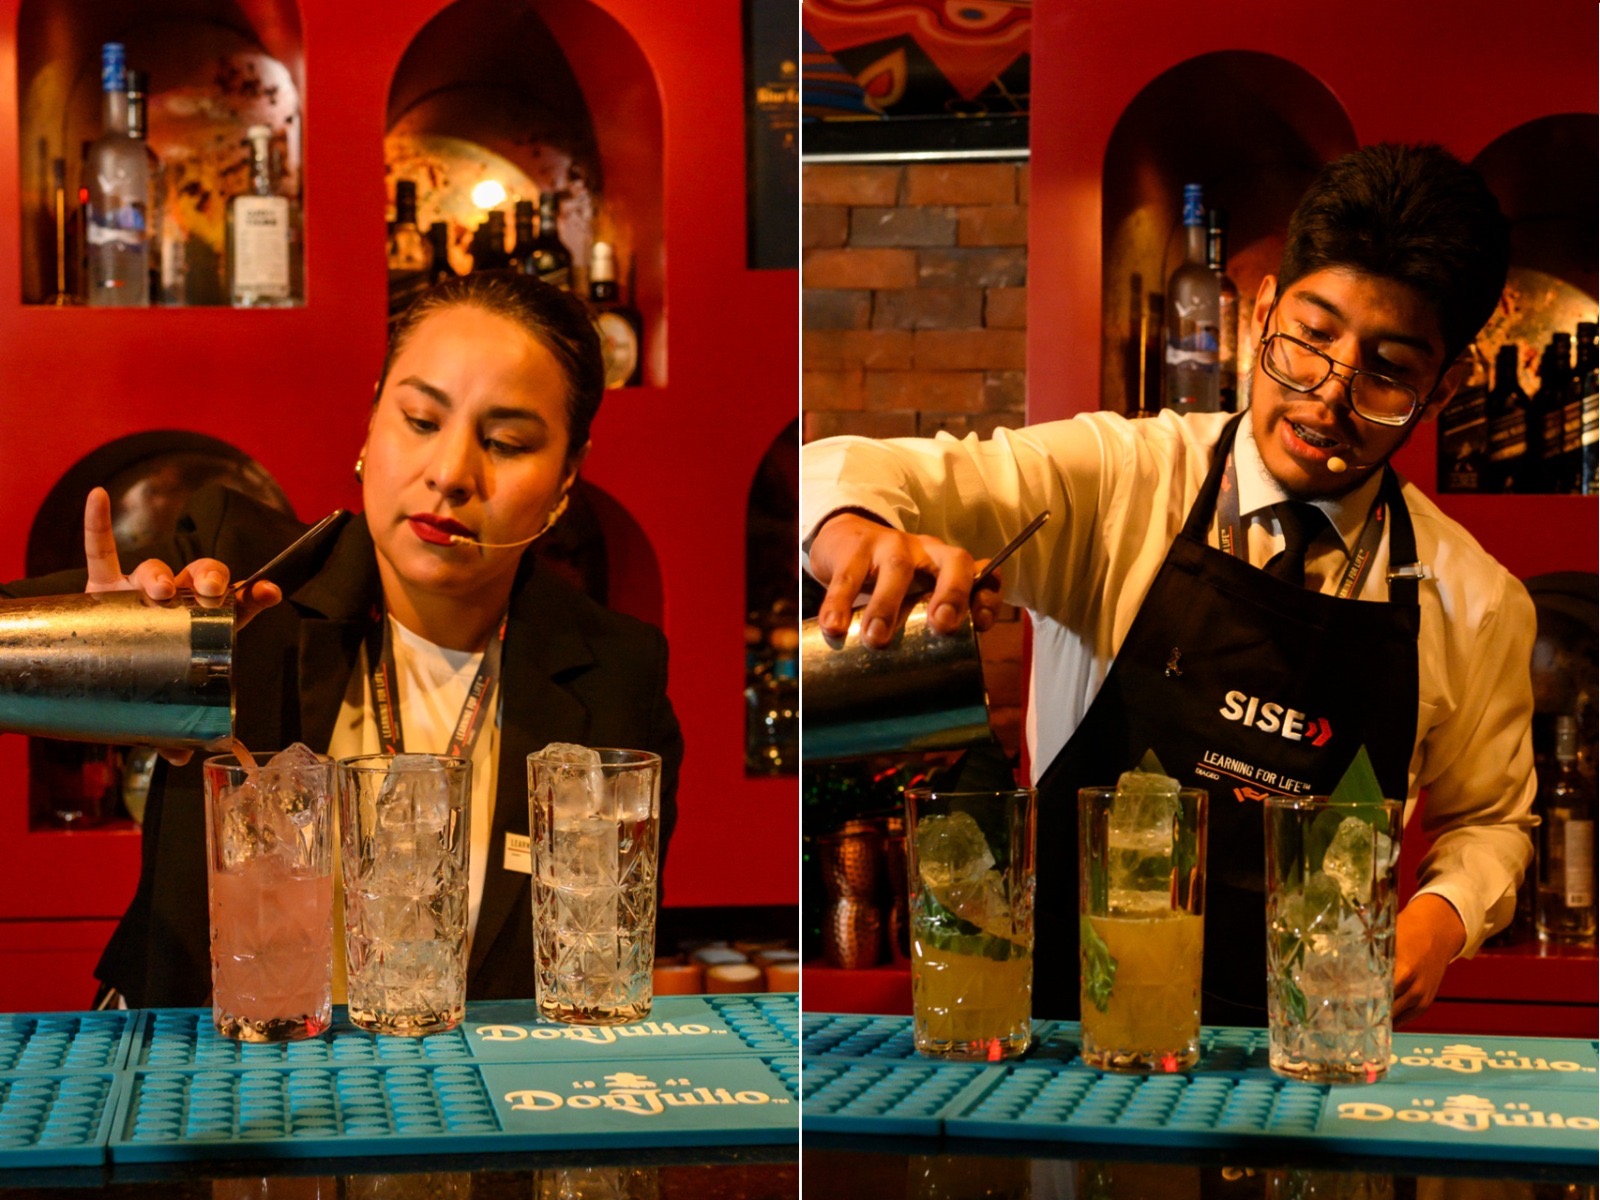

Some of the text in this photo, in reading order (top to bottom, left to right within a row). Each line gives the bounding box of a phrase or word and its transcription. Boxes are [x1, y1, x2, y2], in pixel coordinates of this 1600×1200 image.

[1219, 690, 1305, 741] SISE
[1203, 750, 1254, 777] LEARNING
[1255, 768, 1277, 785] FOR
